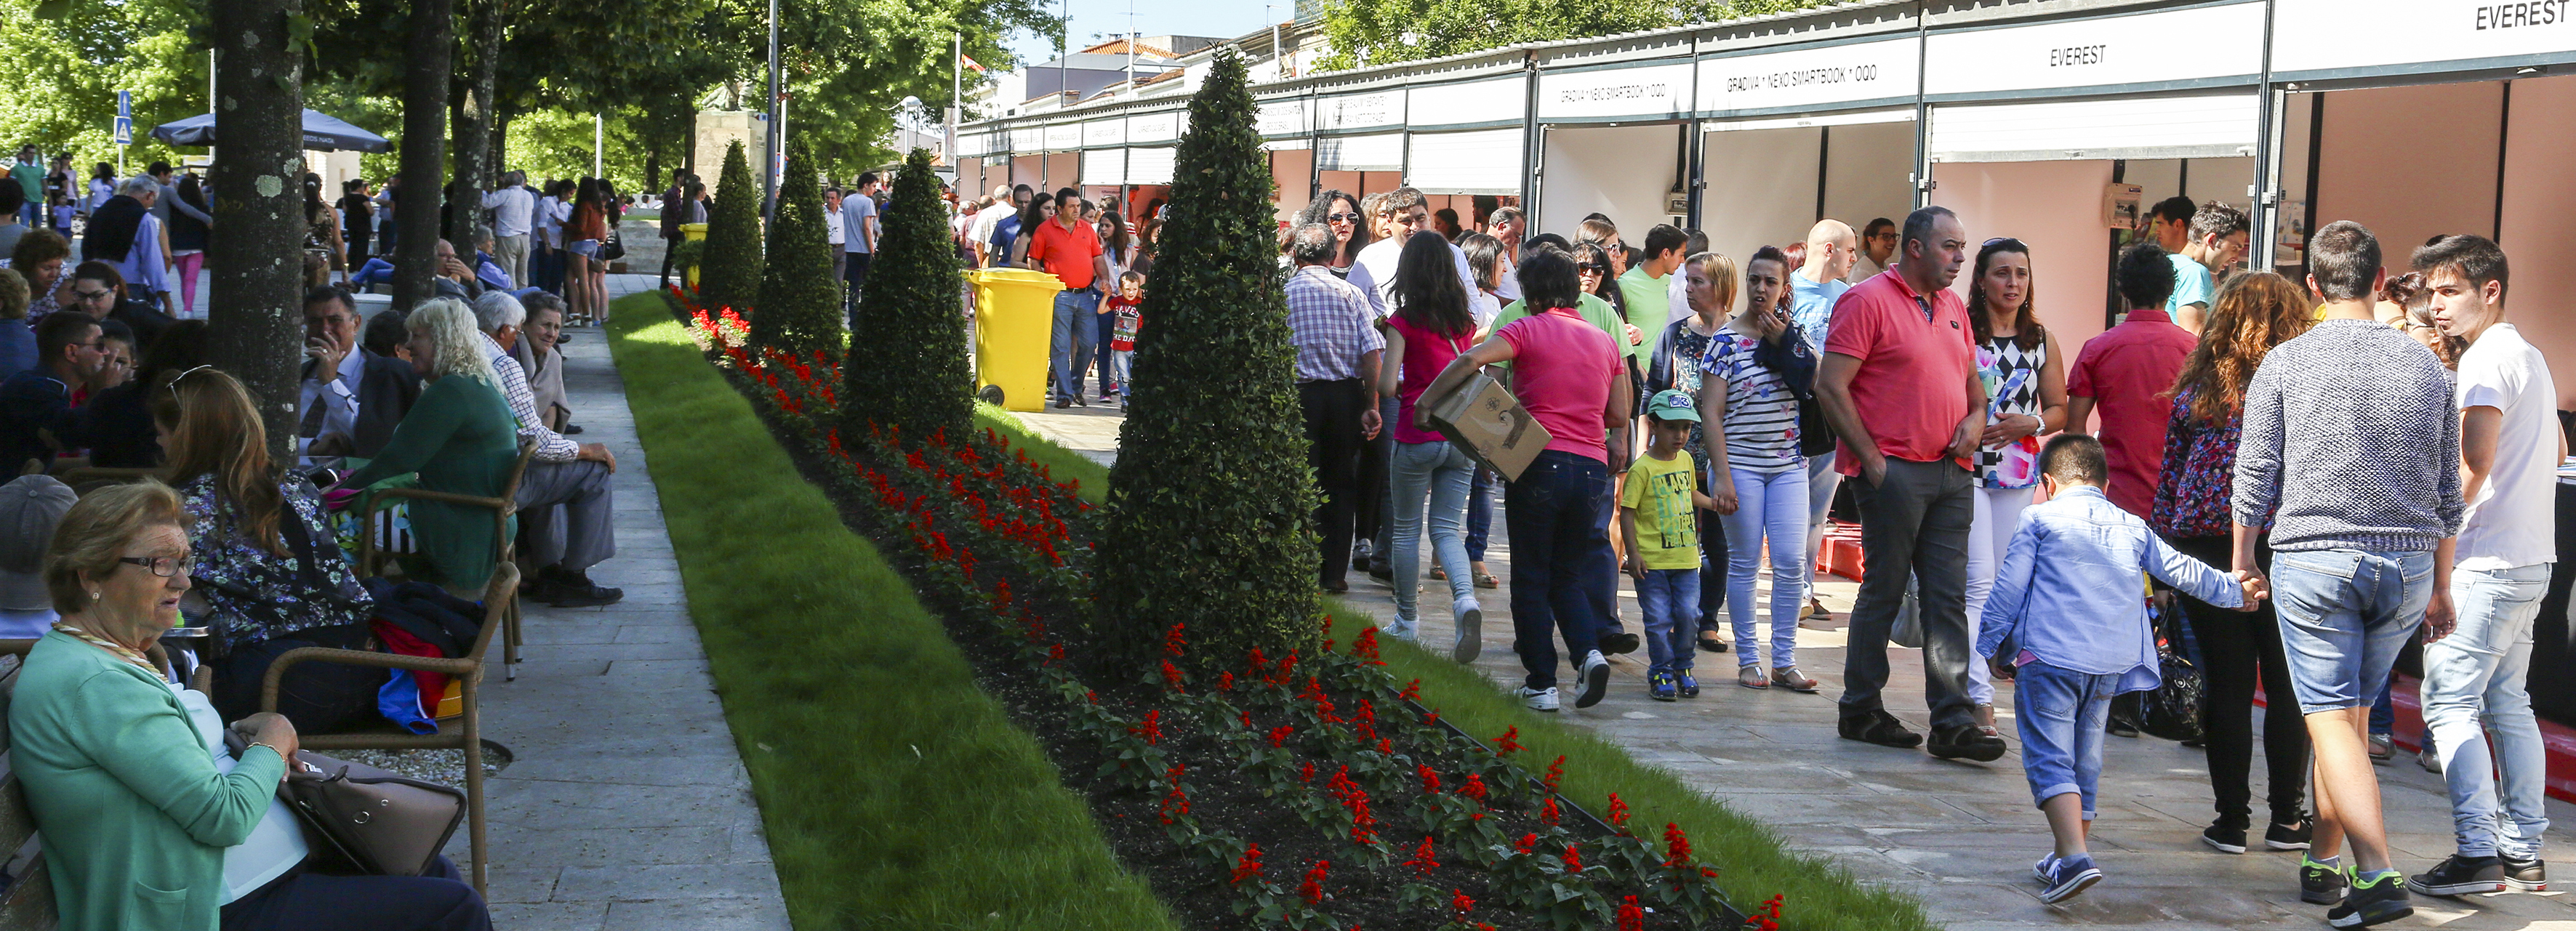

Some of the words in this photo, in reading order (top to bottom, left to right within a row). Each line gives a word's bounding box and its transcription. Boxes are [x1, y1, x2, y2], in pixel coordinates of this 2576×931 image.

[2476, 0, 2570, 31] EVEREST
[2050, 44, 2106, 67] EVEREST
[1727, 76, 1760, 92] GRADIVA
[1768, 72, 1789, 89] NEXO
[1791, 66, 1846, 86] SMARTBOOK
[1855, 64, 1877, 81] OQO
[1561, 89, 1584, 102] GRADIVA
[1590, 87, 1605, 101] NEXO
[1606, 84, 1645, 100] SMARTBOOK
[1650, 83, 1666, 97] OQO
